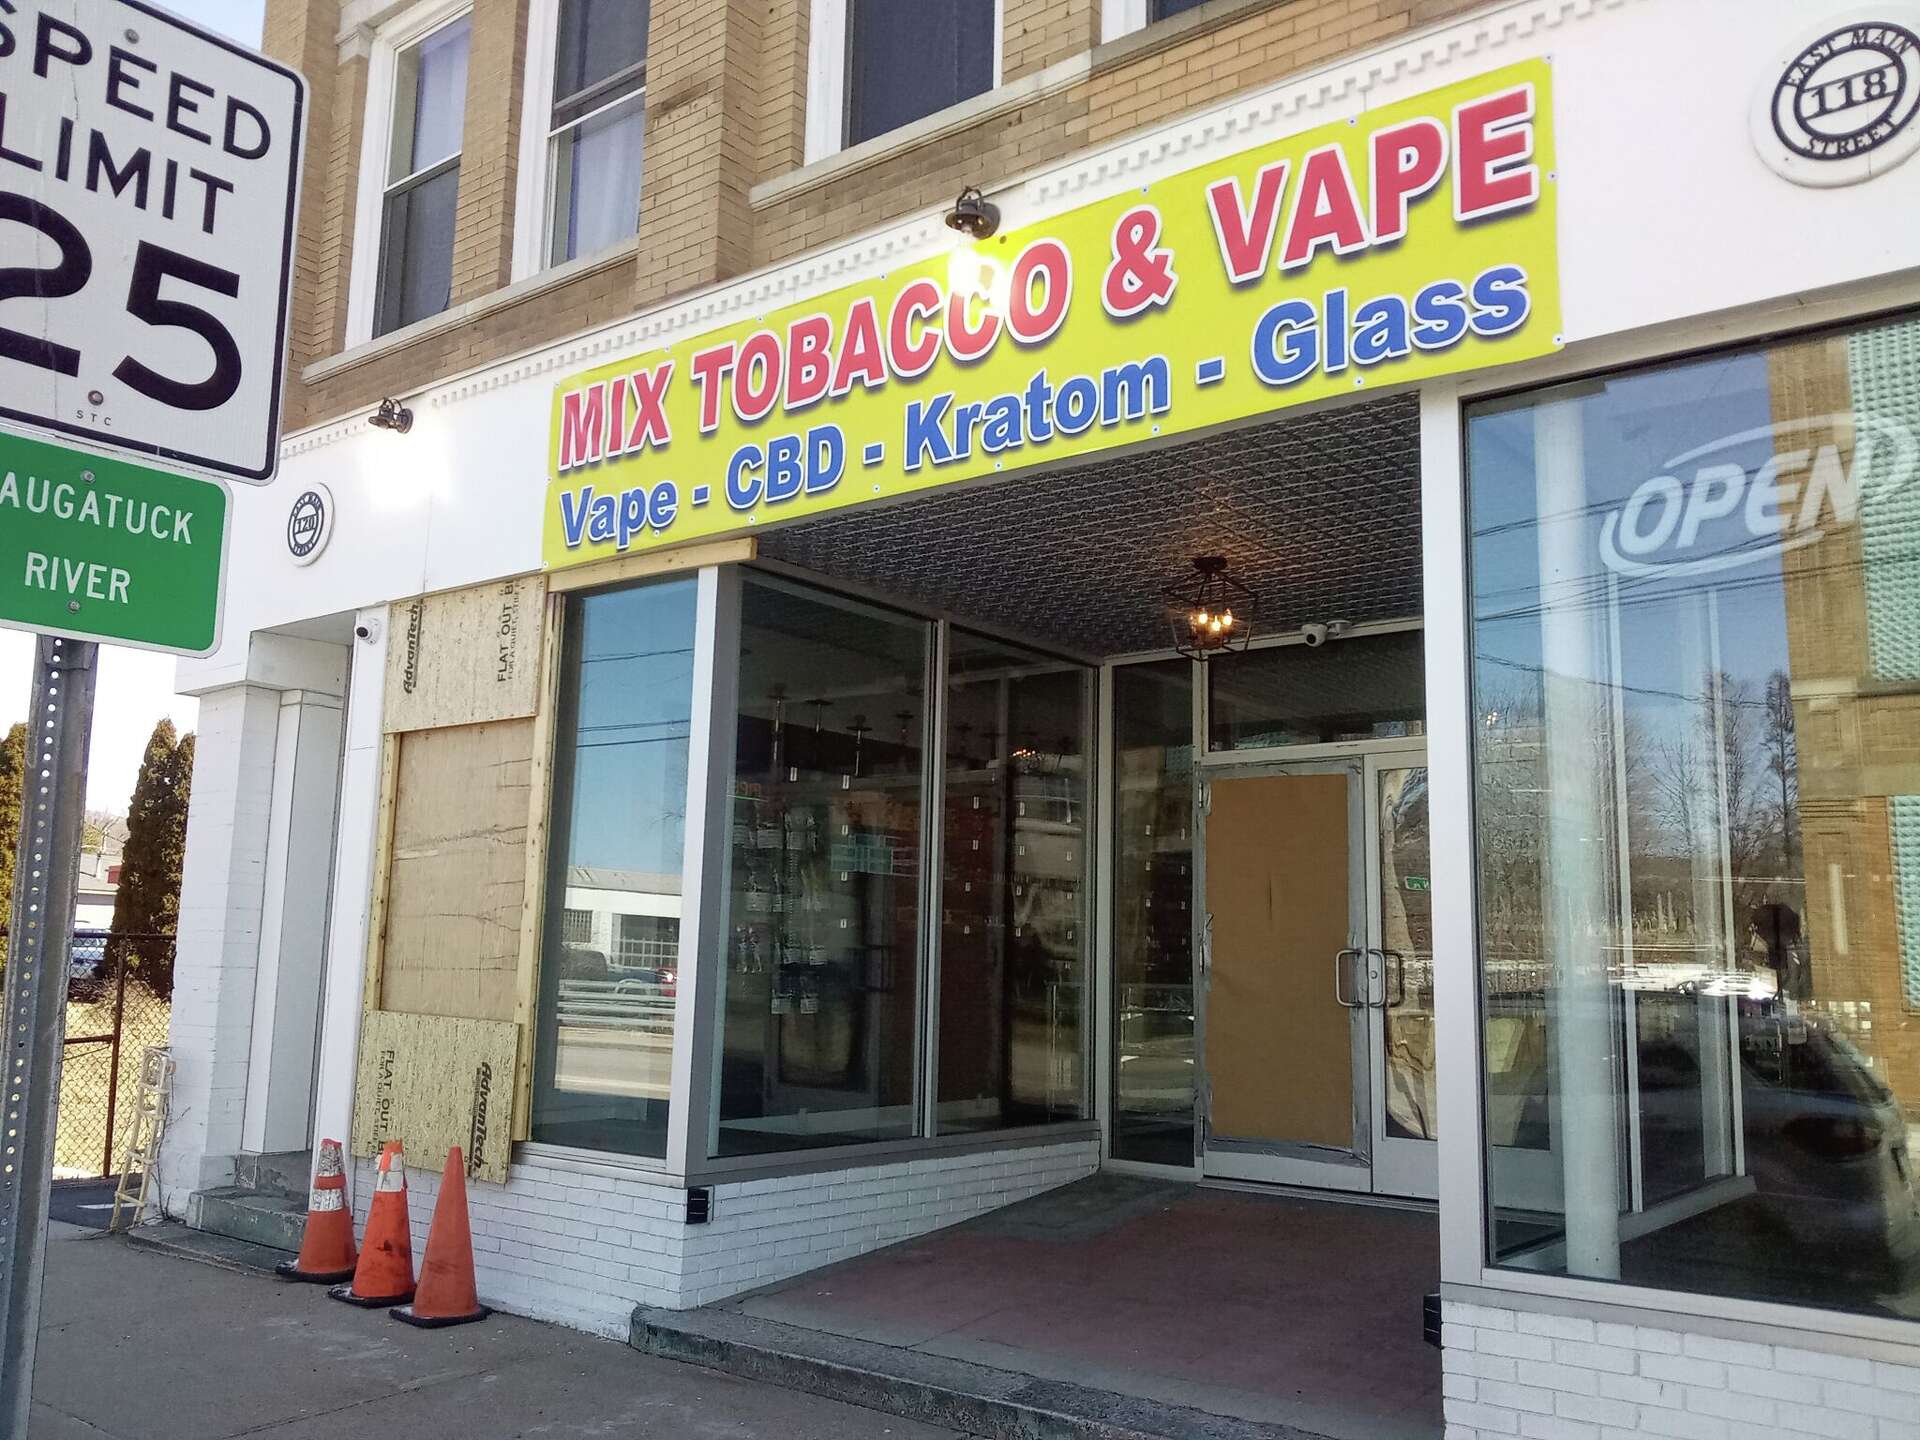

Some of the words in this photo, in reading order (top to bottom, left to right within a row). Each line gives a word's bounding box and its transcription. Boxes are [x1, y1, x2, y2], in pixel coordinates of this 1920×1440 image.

[1782, 37, 1836, 88] EAST
[1849, 28, 1913, 56] MAIN
[1810, 69, 1888, 114] 118
[0, 91, 235, 235] LIMIT
[1803, 112, 1899, 155] STREET
[0, 190, 243, 412] 25
[558, 361, 675, 472] MIX
[692, 237, 1072, 433] TOBACCO
[1103, 205, 1177, 318] &
[1207, 81, 1540, 284] VAPE
[560, 479, 678, 550] Vape
[727, 423, 846, 511] CBD
[904, 354, 1172, 472] Kratom
[1252, 263, 1531, 386] Glass
[0, 471, 194, 545] AUGATUCK
[1618, 434, 1873, 556] OPEN
[24, 551, 132, 604] RIVER
[402, 603, 419, 695] AdvanTech
[501, 603, 513, 636] OUT
[497, 643, 509, 682] FLAT
[383, 1050, 395, 1090] FLAT
[380, 1098, 391, 1133] OUT
[474, 1061, 493, 1169] AdvanTech
